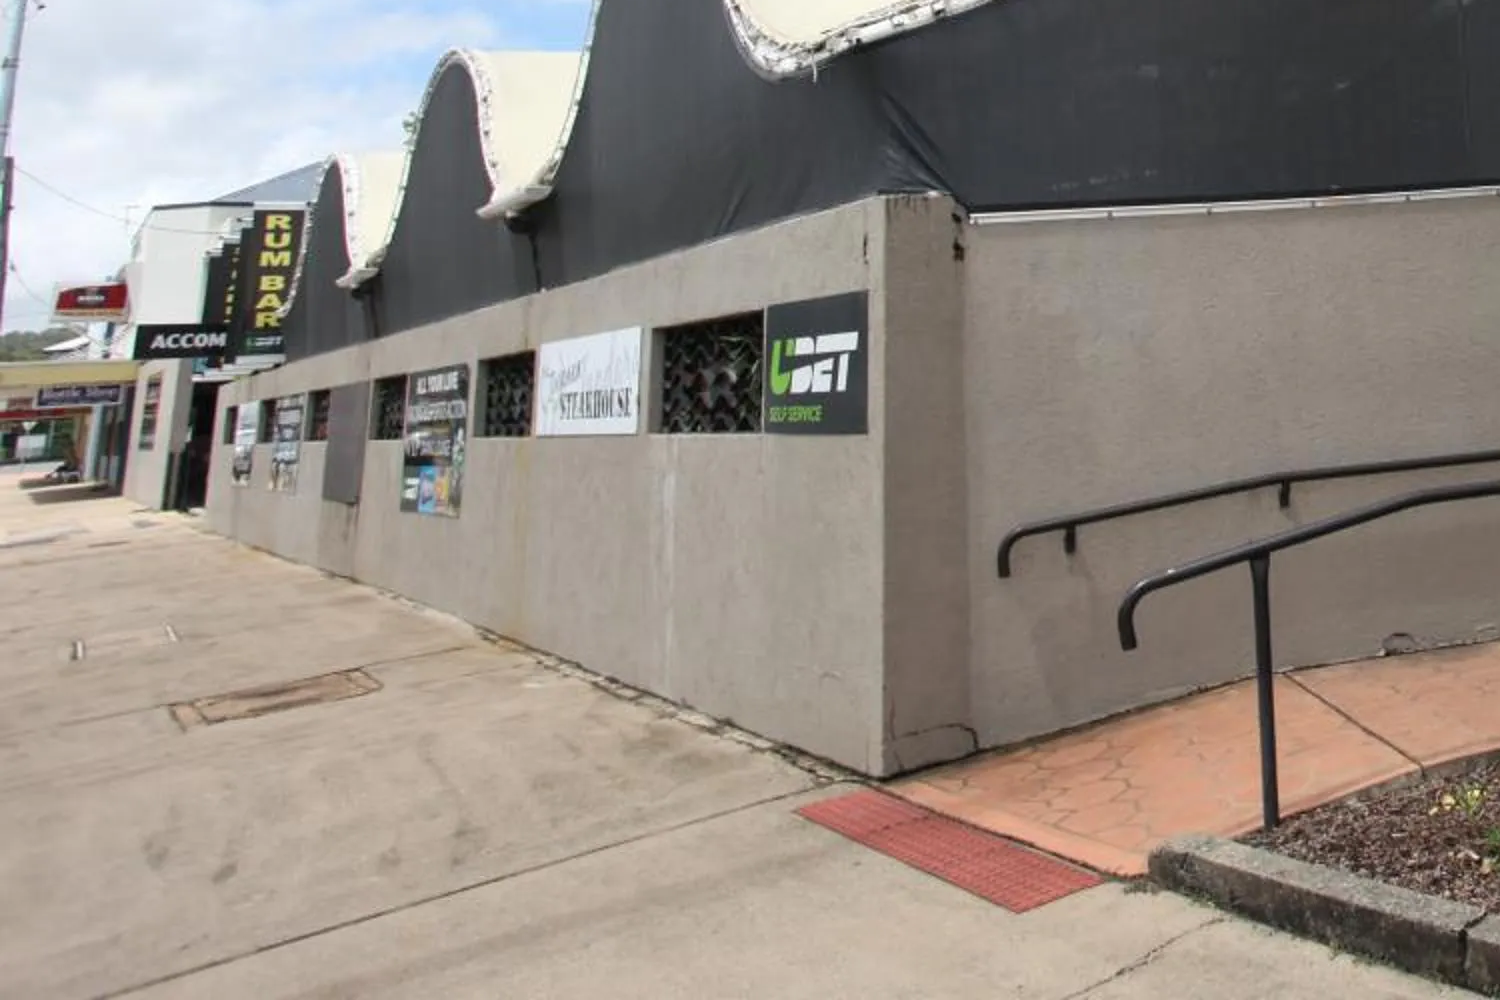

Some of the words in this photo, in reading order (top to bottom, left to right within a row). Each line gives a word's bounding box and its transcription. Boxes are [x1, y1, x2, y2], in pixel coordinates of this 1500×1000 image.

[259, 213, 292, 267] RUM
[255, 275, 286, 329] BAR
[151, 332, 227, 349] ACCOM
[770, 331, 859, 395] UBET
[560, 387, 633, 420] STEAKHOUSE
